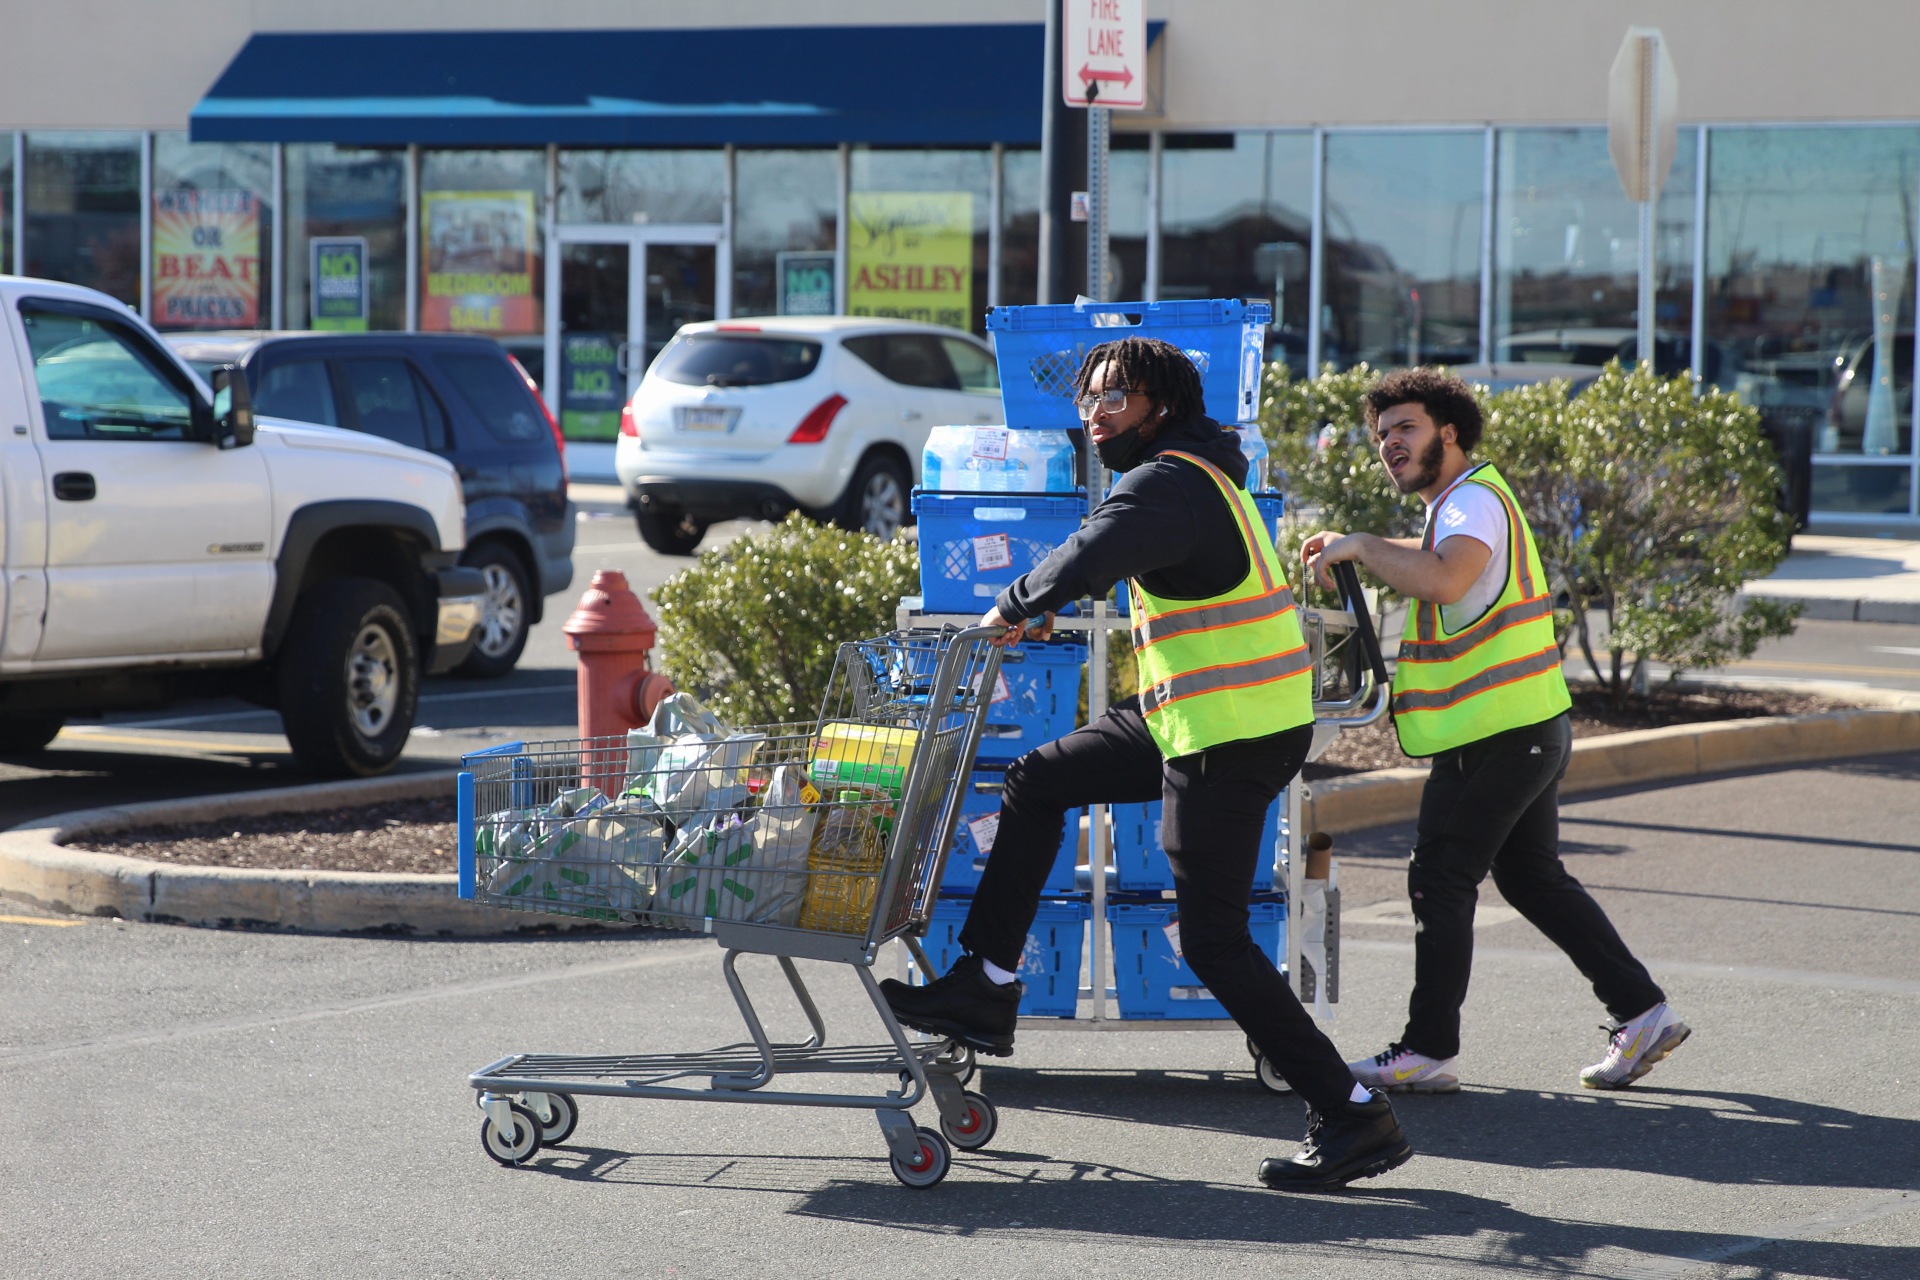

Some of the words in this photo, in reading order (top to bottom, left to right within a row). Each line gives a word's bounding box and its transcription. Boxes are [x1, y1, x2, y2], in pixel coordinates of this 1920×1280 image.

[1090, 0, 1121, 20] FIRE
[1088, 28, 1124, 57] LANE
[192, 226, 222, 247] OR
[159, 254, 257, 279] BEAT
[320, 253, 359, 279] NO
[853, 264, 967, 292] ASHLEY
[427, 272, 531, 297] BEDROOM
[786, 267, 831, 296] NO
[166, 296, 245, 318] PRICES
[449, 304, 503, 330] SALE
[573, 370, 610, 393] NO
